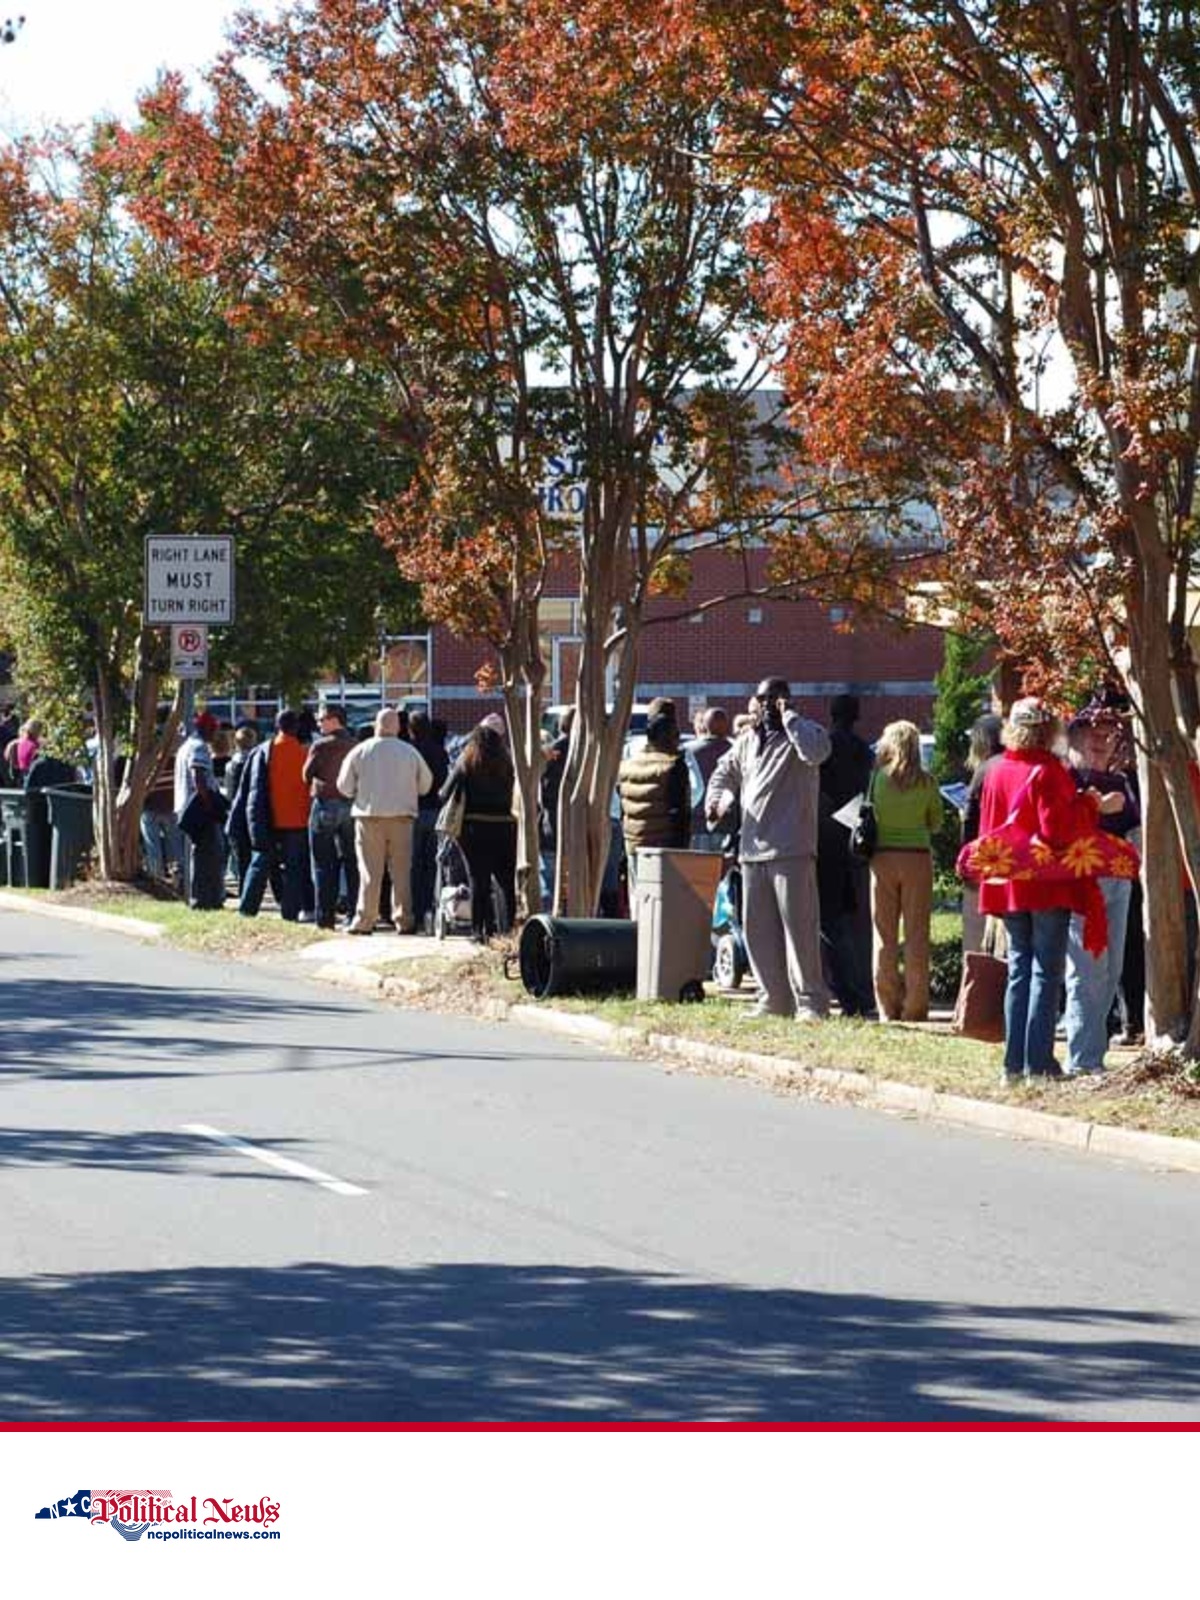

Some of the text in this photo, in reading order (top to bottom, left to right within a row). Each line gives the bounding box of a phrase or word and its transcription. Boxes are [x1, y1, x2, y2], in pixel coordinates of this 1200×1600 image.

[152, 548, 227, 562] RIGHT LANE
[167, 572, 212, 588] MUST
[151, 599, 227, 613] TURN RIGHT
